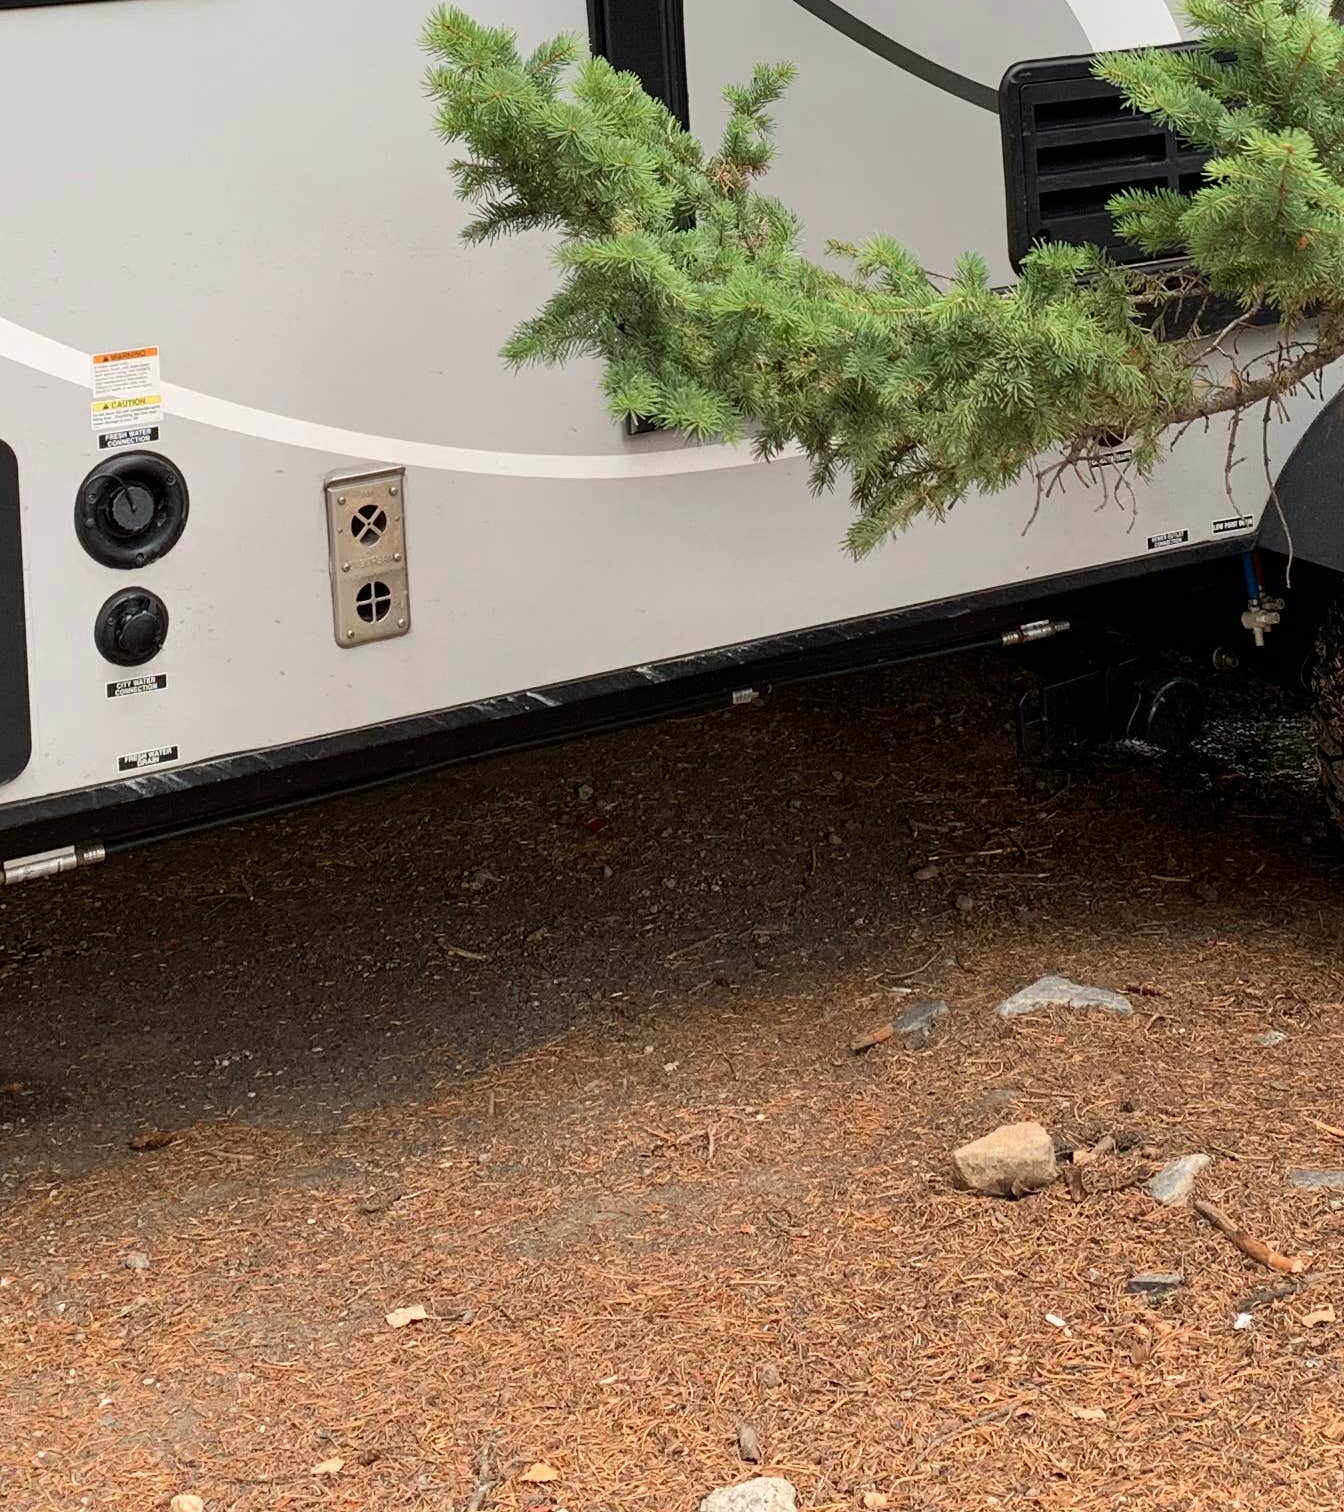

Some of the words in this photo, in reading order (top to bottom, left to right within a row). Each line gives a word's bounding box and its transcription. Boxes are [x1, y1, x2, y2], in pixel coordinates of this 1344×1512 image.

[111, 398, 146, 409] CAUTION
[105, 431, 128, 441] FRESH
[128, 428, 152, 437] WATER
[107, 435, 151, 447] CONNECTION
[116, 681, 132, 690] CITY
[133, 676, 156, 686] WATER
[114, 683, 158, 696] CONNECTION
[148, 747, 173, 757] WATER
